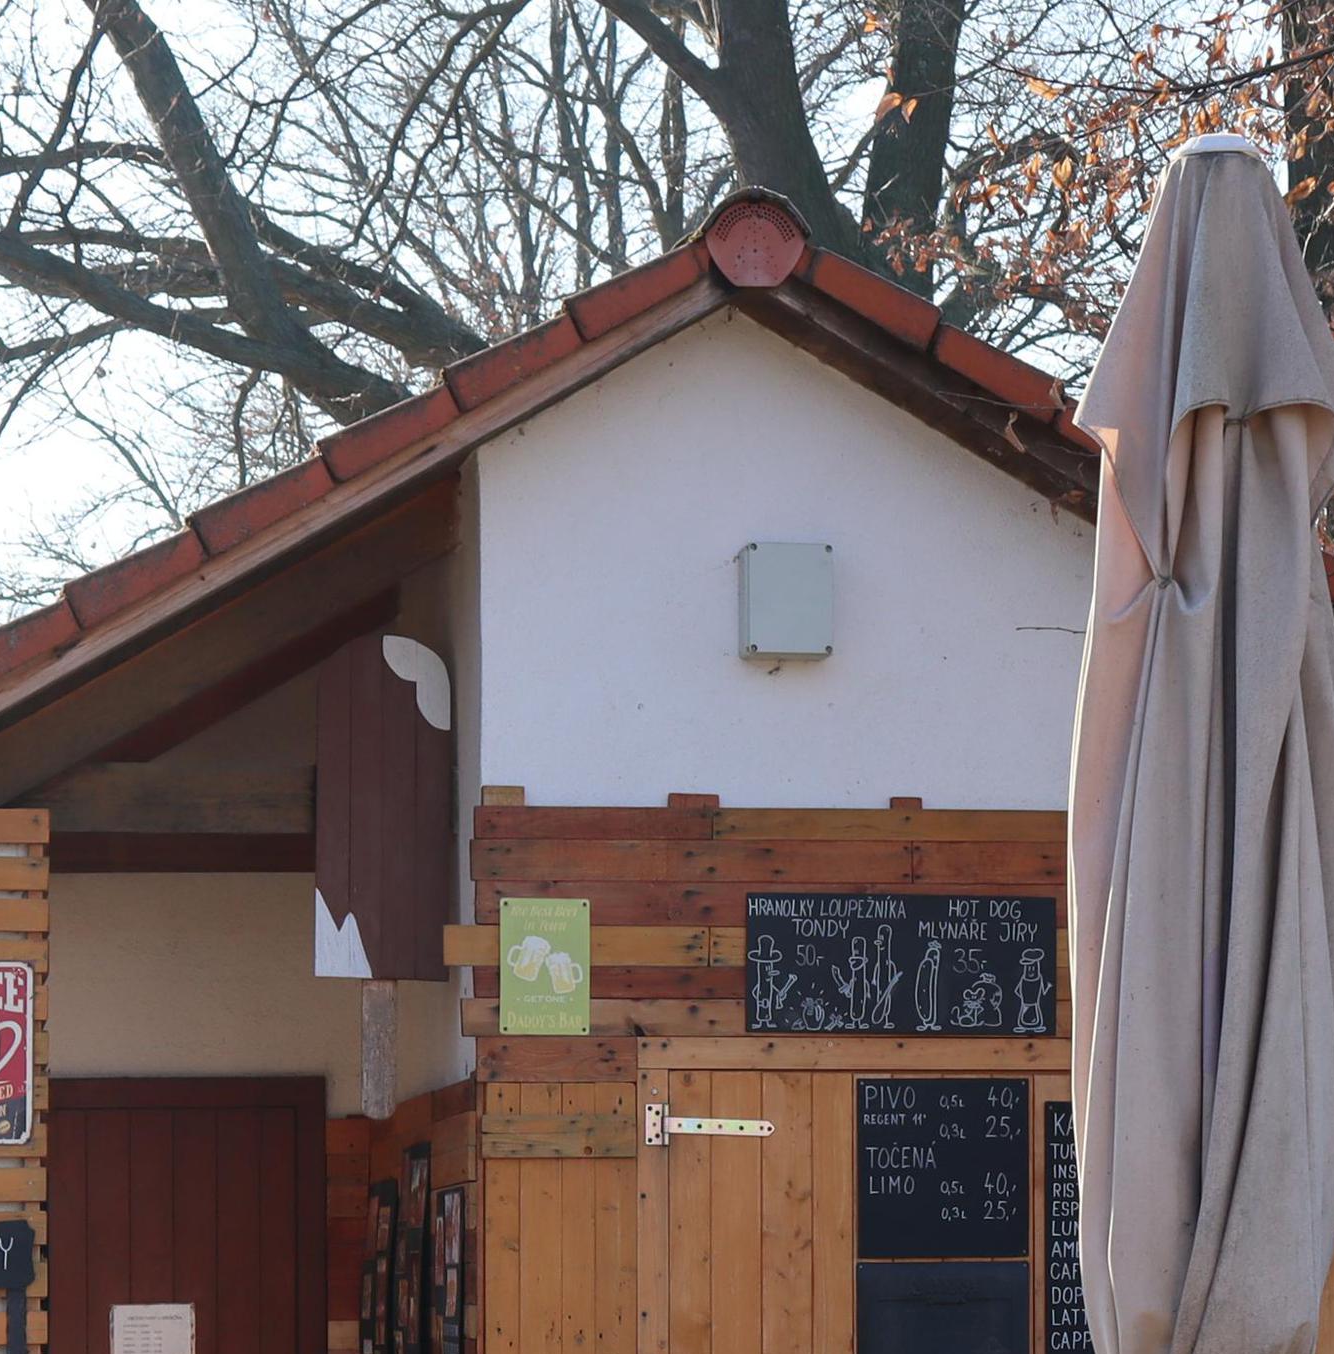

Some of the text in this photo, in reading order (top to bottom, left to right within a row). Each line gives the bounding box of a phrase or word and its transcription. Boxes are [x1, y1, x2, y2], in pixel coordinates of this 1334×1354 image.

[748, 895, 907, 919] HRANOLKY LOUPEŽNÍKA
[948, 899, 1022, 919] HOT DOG
[791, 918, 850, 939] TONDY
[918, 919, 1038, 942] MLYNÁŘE JÍRY
[865, 1085, 916, 1109] PIVO
[863, 1114, 907, 1125] REGENT
[865, 1140, 937, 1169] TOČENÁ
[1050, 1143, 1077, 1160] TUR
[1053, 1164, 1077, 1179] INS
[869, 1175, 916, 1195] LIMO
[1053, 1183, 1080, 1198] RIS
[1052, 1201, 1079, 1216] ESP
[1050, 1262, 1080, 1280] CAF
[1051, 1286, 1083, 1305] DOP
[1051, 1308, 1088, 1326] LATT
[1051, 1331, 1092, 1350] CAPP
